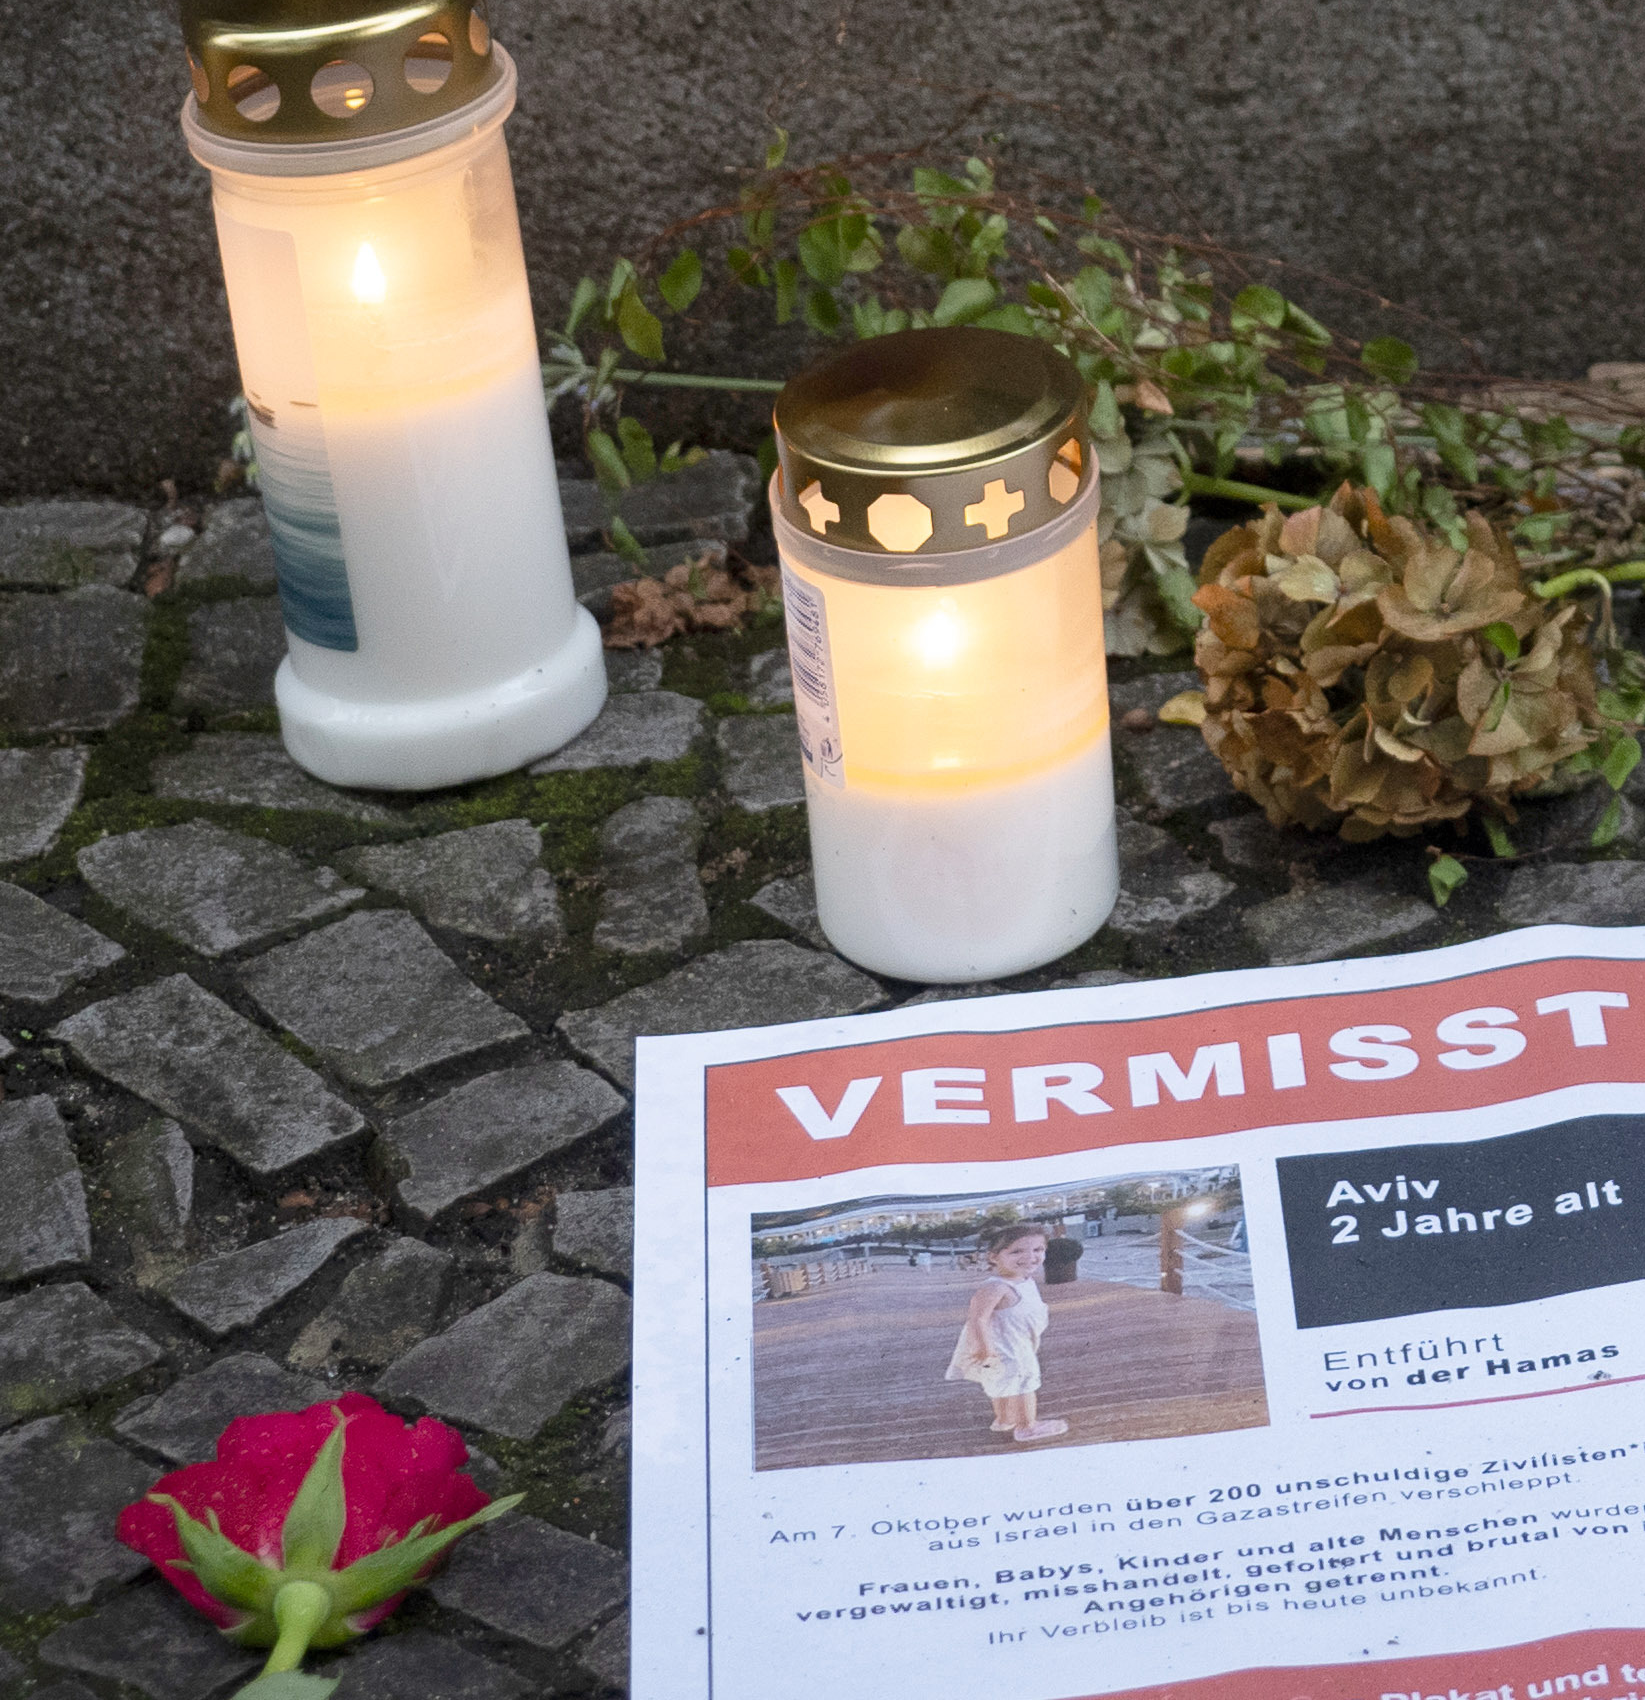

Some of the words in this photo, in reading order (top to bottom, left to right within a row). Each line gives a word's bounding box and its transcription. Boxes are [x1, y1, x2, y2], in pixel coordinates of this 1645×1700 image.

[775, 991, 1631, 1141] VERMISST
[1324, 1173, 1441, 1209] Aviv
[1329, 1213, 1361, 1246] 2
[1380, 1202, 1534, 1239] Jahre
[1553, 1178, 1624, 1216] alt
[1322, 1332, 1505, 1372] Entführt
[1324, 1377, 1390, 1393] von
[1405, 1365, 1471, 1387] der
[1485, 1344, 1621, 1377] Hamas
[768, 1529, 817, 1545] Am
[832, 1525, 858, 1540] 7.
[870, 1514, 991, 1536] Oktober
[1002, 1502, 1113, 1524] wurden
[1125, 1494, 1197, 1513] über
[1208, 1482, 1263, 1505] 200
[1274, 1466, 1470, 1496] unschuldige
[927, 1530, 982, 1553] aus
[994, 1520, 1079, 1545] Israel
[1090, 1521, 1117, 1534] in
[1127, 1516, 1183, 1532] den
[1195, 1490, 1388, 1526] Gazastreifen
[1399, 1472, 1580, 1501] verschleppt.
[795, 1591, 1010, 1623] vergewaltigt,
[1022, 1566, 1232, 1603] misshandelt,
[1244, 1549, 1383, 1579] gefoltert
[1395, 1542, 1455, 1562] und
[1466, 1525, 1560, 1554] brutal
[1571, 1523, 1630, 1537] von
[857, 1577, 981, 1598] Frauen,
[994, 1562, 1105, 1586] Babys,
[1117, 1549, 1224, 1572] Kinder
[1236, 1540, 1296, 1559] und
[1308, 1534, 1366, 1554] alte
[1378, 1513, 1539, 1543] Menschen
[1082, 1581, 1292, 1616] Angehörigen
[1303, 1564, 1450, 1595] getrennt.
[987, 1629, 1028, 1646] Ihr
[1039, 1613, 1168, 1640] Verbleib
[1179, 1606, 1215, 1625] ist
[1226, 1600, 1271, 1617] bis
[1282, 1593, 1368, 1612] heute
[1379, 1567, 1548, 1602] unbekannt.
[1526, 1663, 1610, 1700] und
